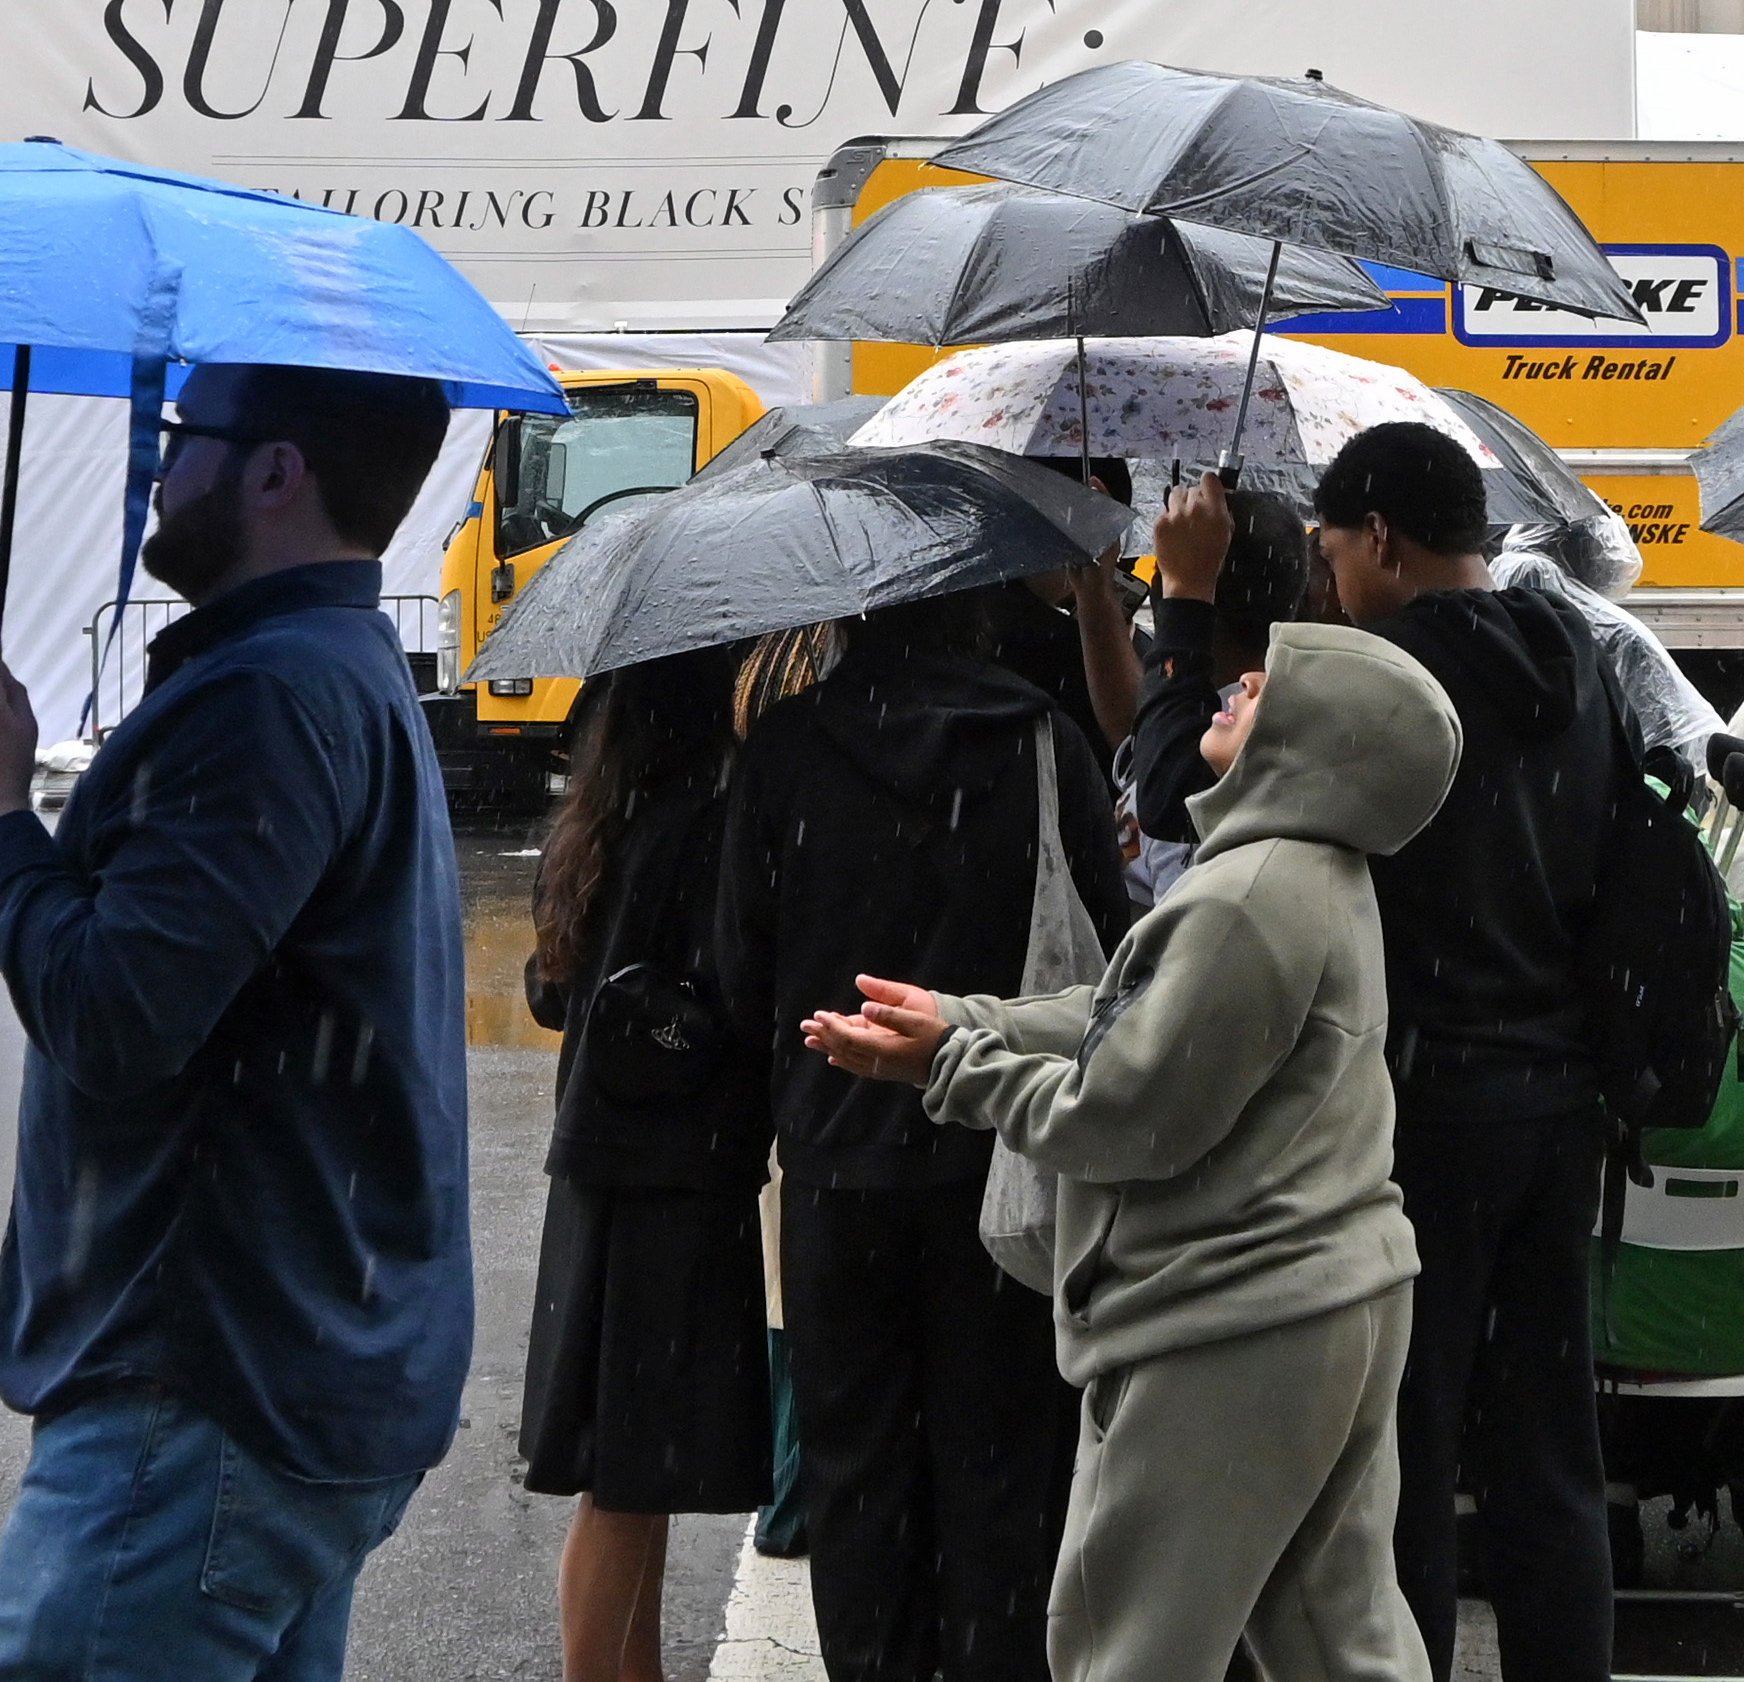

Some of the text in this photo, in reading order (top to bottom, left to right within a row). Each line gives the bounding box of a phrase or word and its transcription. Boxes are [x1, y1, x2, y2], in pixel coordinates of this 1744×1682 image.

[579, 187, 758, 229] BLACK
[1502, 355, 1676, 380] Truck Rental
